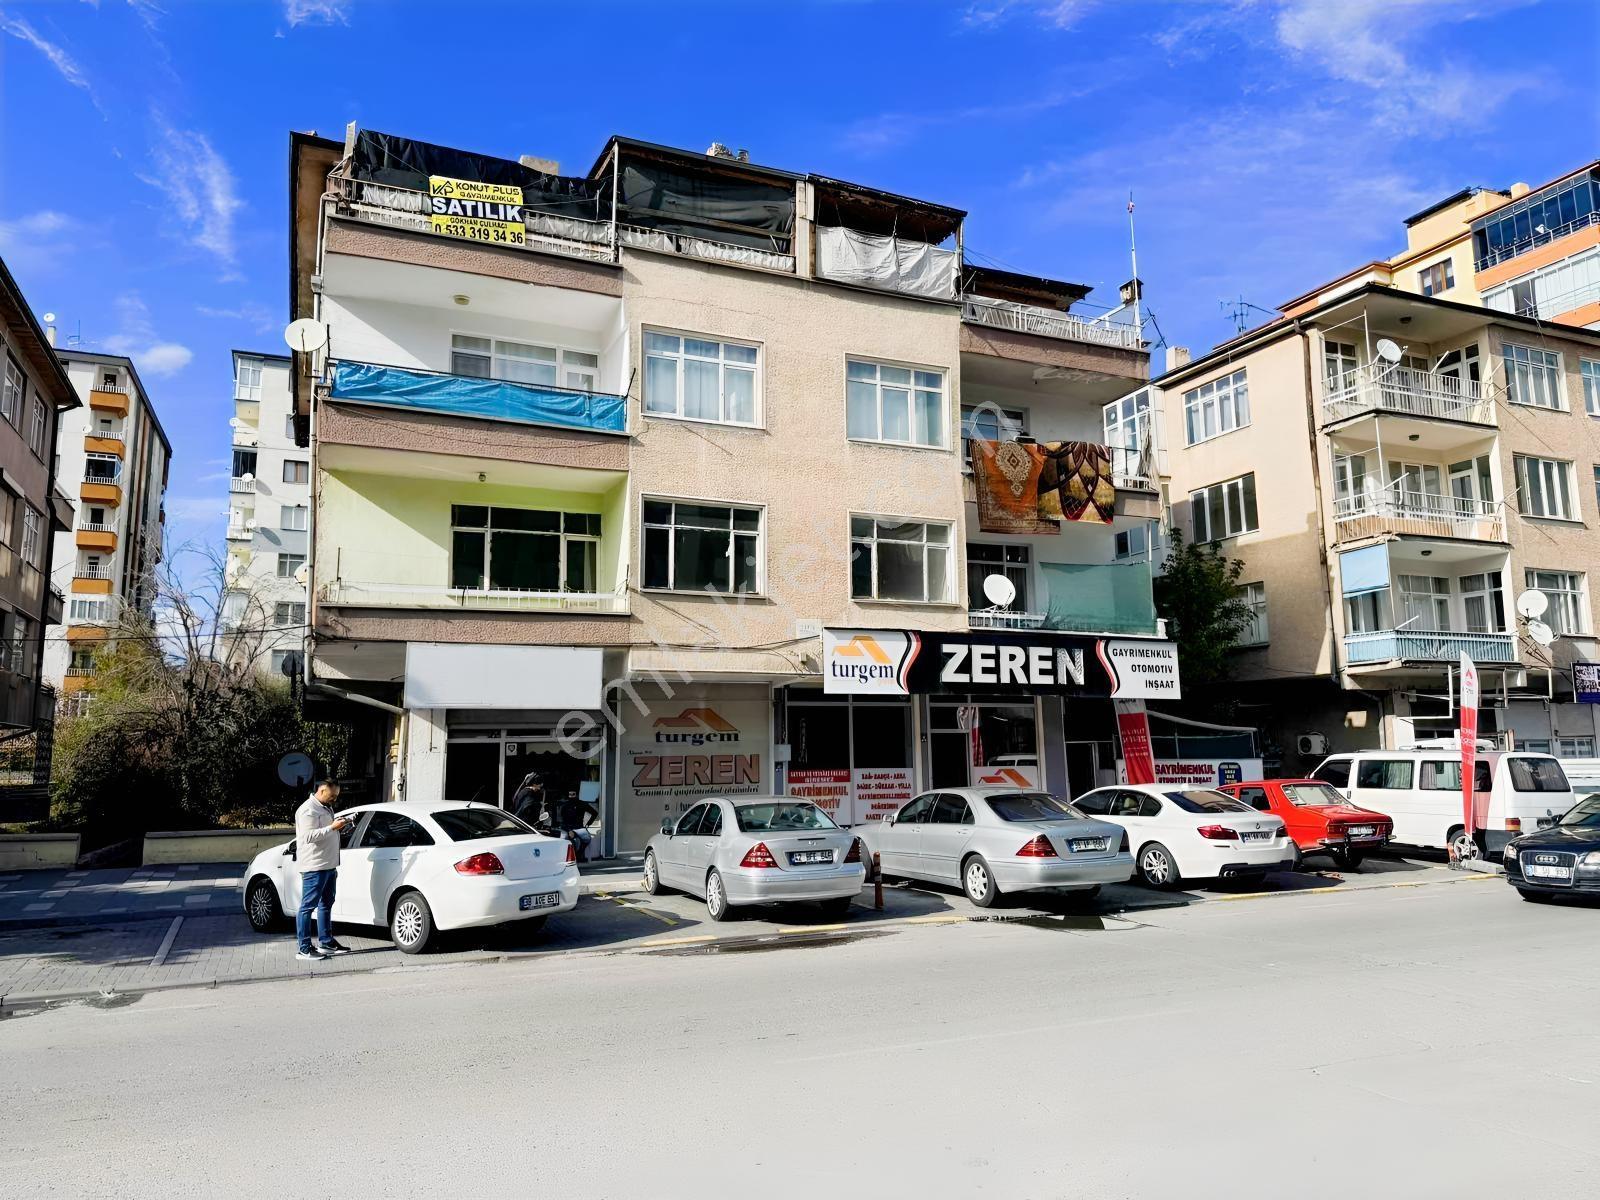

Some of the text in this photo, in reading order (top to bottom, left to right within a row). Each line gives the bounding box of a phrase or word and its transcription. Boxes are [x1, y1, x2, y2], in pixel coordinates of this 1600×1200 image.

[456, 181, 520, 196] KONUT PLUS
[432, 197, 523, 222] SATILIK
[469, 226, 490, 240] 319
[493, 229, 507, 242] 34
[510, 231, 523, 244] 36
[831, 659, 894, 684] turgem
[941, 643, 1084, 686] ZEREN
[655, 731, 740, 746] turgem
[632, 754, 760, 787] ZEREN
